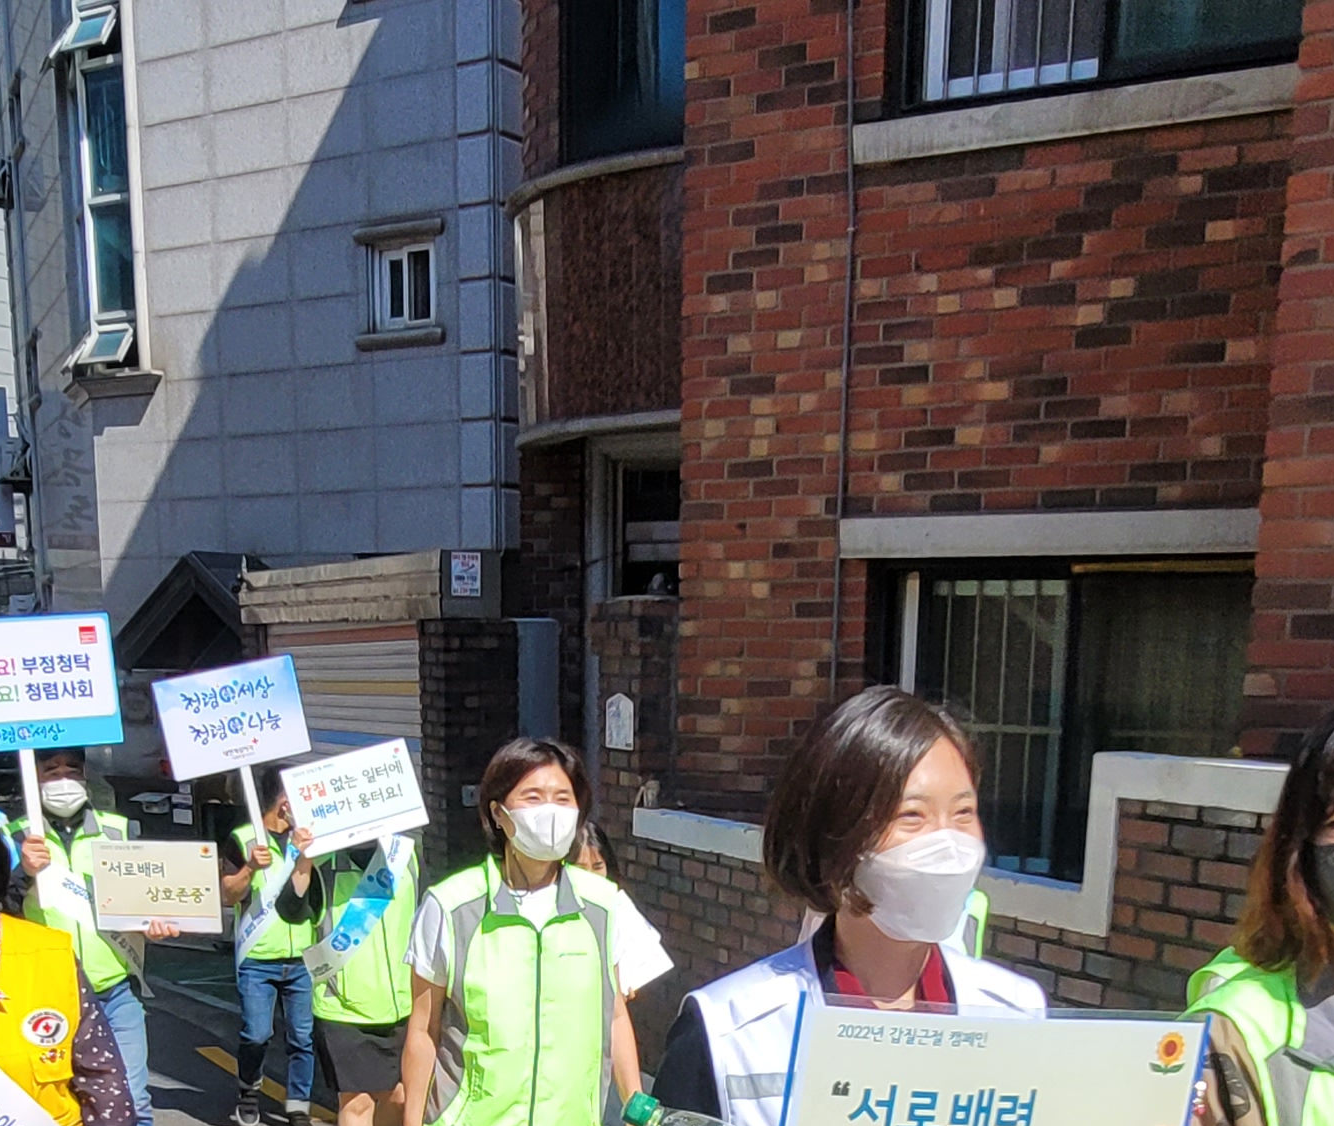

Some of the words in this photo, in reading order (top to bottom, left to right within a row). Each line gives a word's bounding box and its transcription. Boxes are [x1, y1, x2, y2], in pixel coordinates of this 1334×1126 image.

[21, 652, 91, 676] 부정청탁
[24, 678, 94, 702] 청렴사회
[297, 780, 328, 802] 갑질
[329, 774, 359, 794] 없는
[361, 759, 405, 785] 일터에
[311, 797, 353, 820] 배려가
[837, 1024, 885, 1042] 2022년
[889, 1027, 945, 1047] 갑질근절
[949, 1030, 989, 1048] 캠페인
